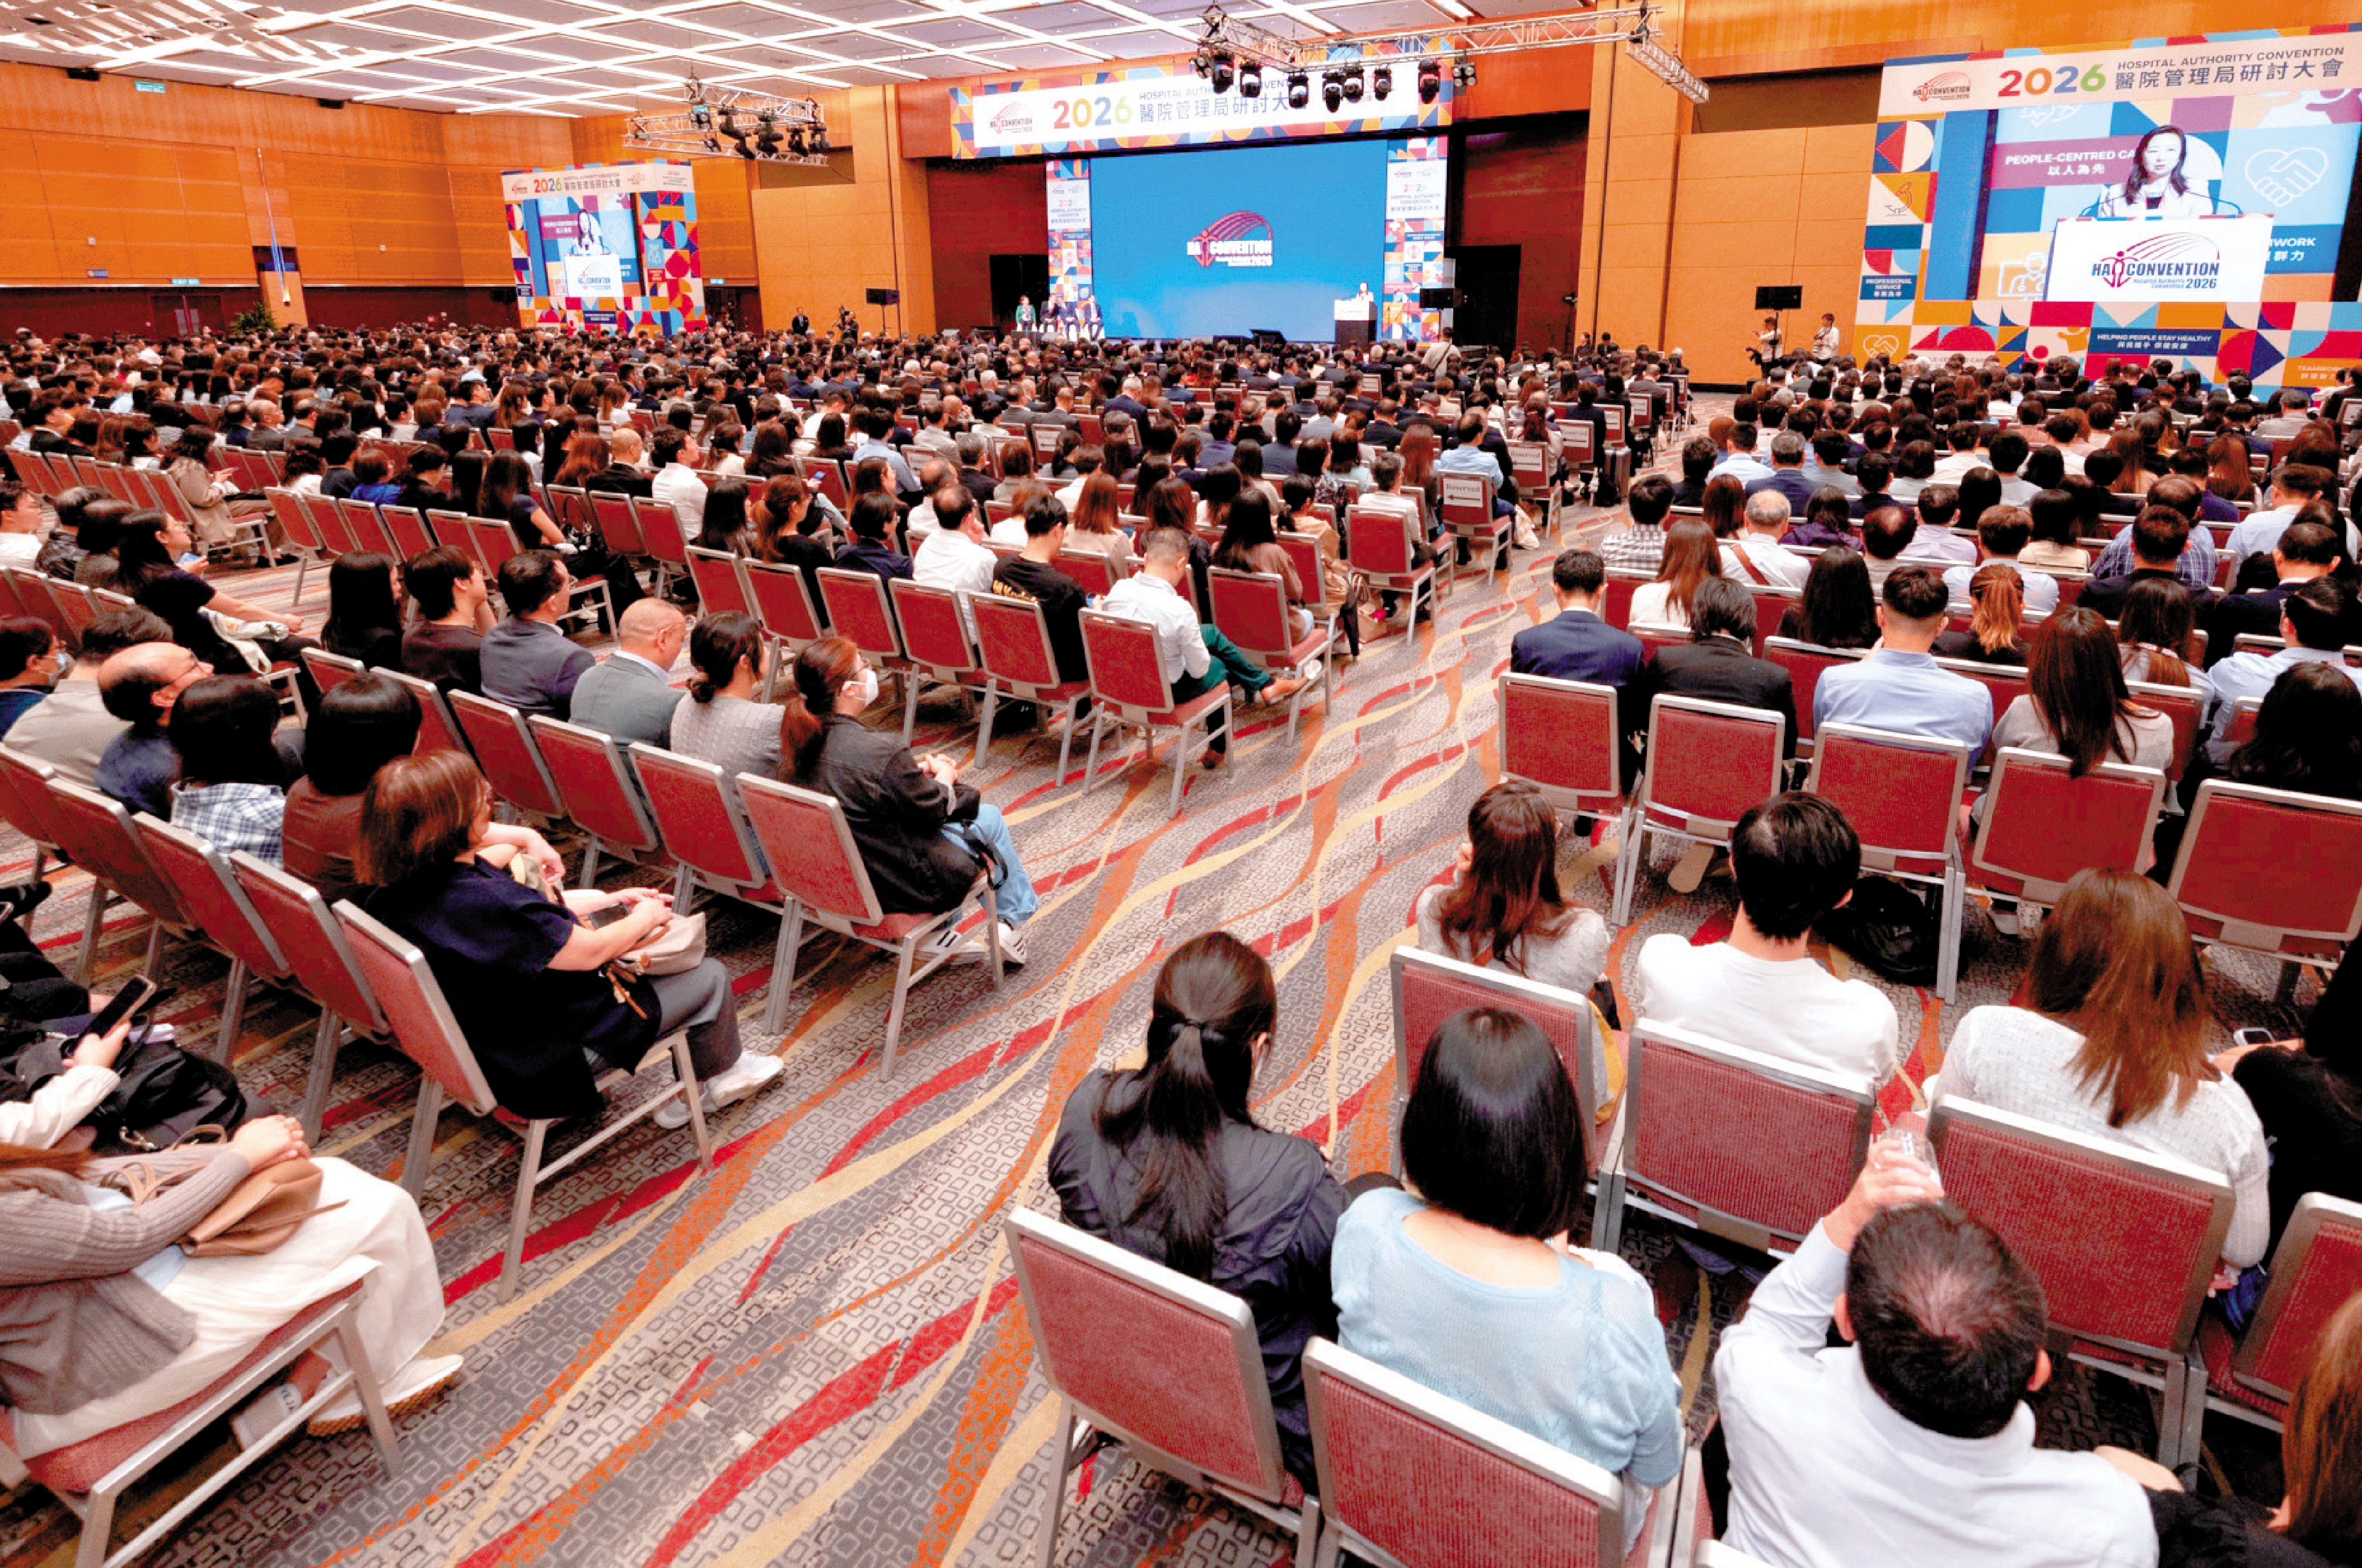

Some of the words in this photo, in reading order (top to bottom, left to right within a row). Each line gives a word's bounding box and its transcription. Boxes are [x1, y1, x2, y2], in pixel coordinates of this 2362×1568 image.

[2118, 59, 2175, 70] HOSPITAL
[2181, 54, 2252, 66] AUTHORITY
[2257, 47, 2344, 61] CONVENTION
[1998, 64, 2106, 97] 2026
[2115, 59, 2343, 90] 醫院管理局研討大會
[1140, 90, 1182, 100] HOSPITAL
[1929, 86, 1971, 95] CONVENTION
[1052, 96, 1132, 129] 2026
[2005, 151, 2115, 165] PEOPLE-CENTRED
[2047, 163, 2105, 176] 以人為先
[533, 178, 562, 193] 2026
[1210, 240, 1273, 254] CONVENTION
[2092, 263, 2110, 276] HA
[2126, 262, 2219, 276] CONVENTION
[2185, 278, 2218, 289] 2026
[1446, 484, 1481, 492] Reserved
